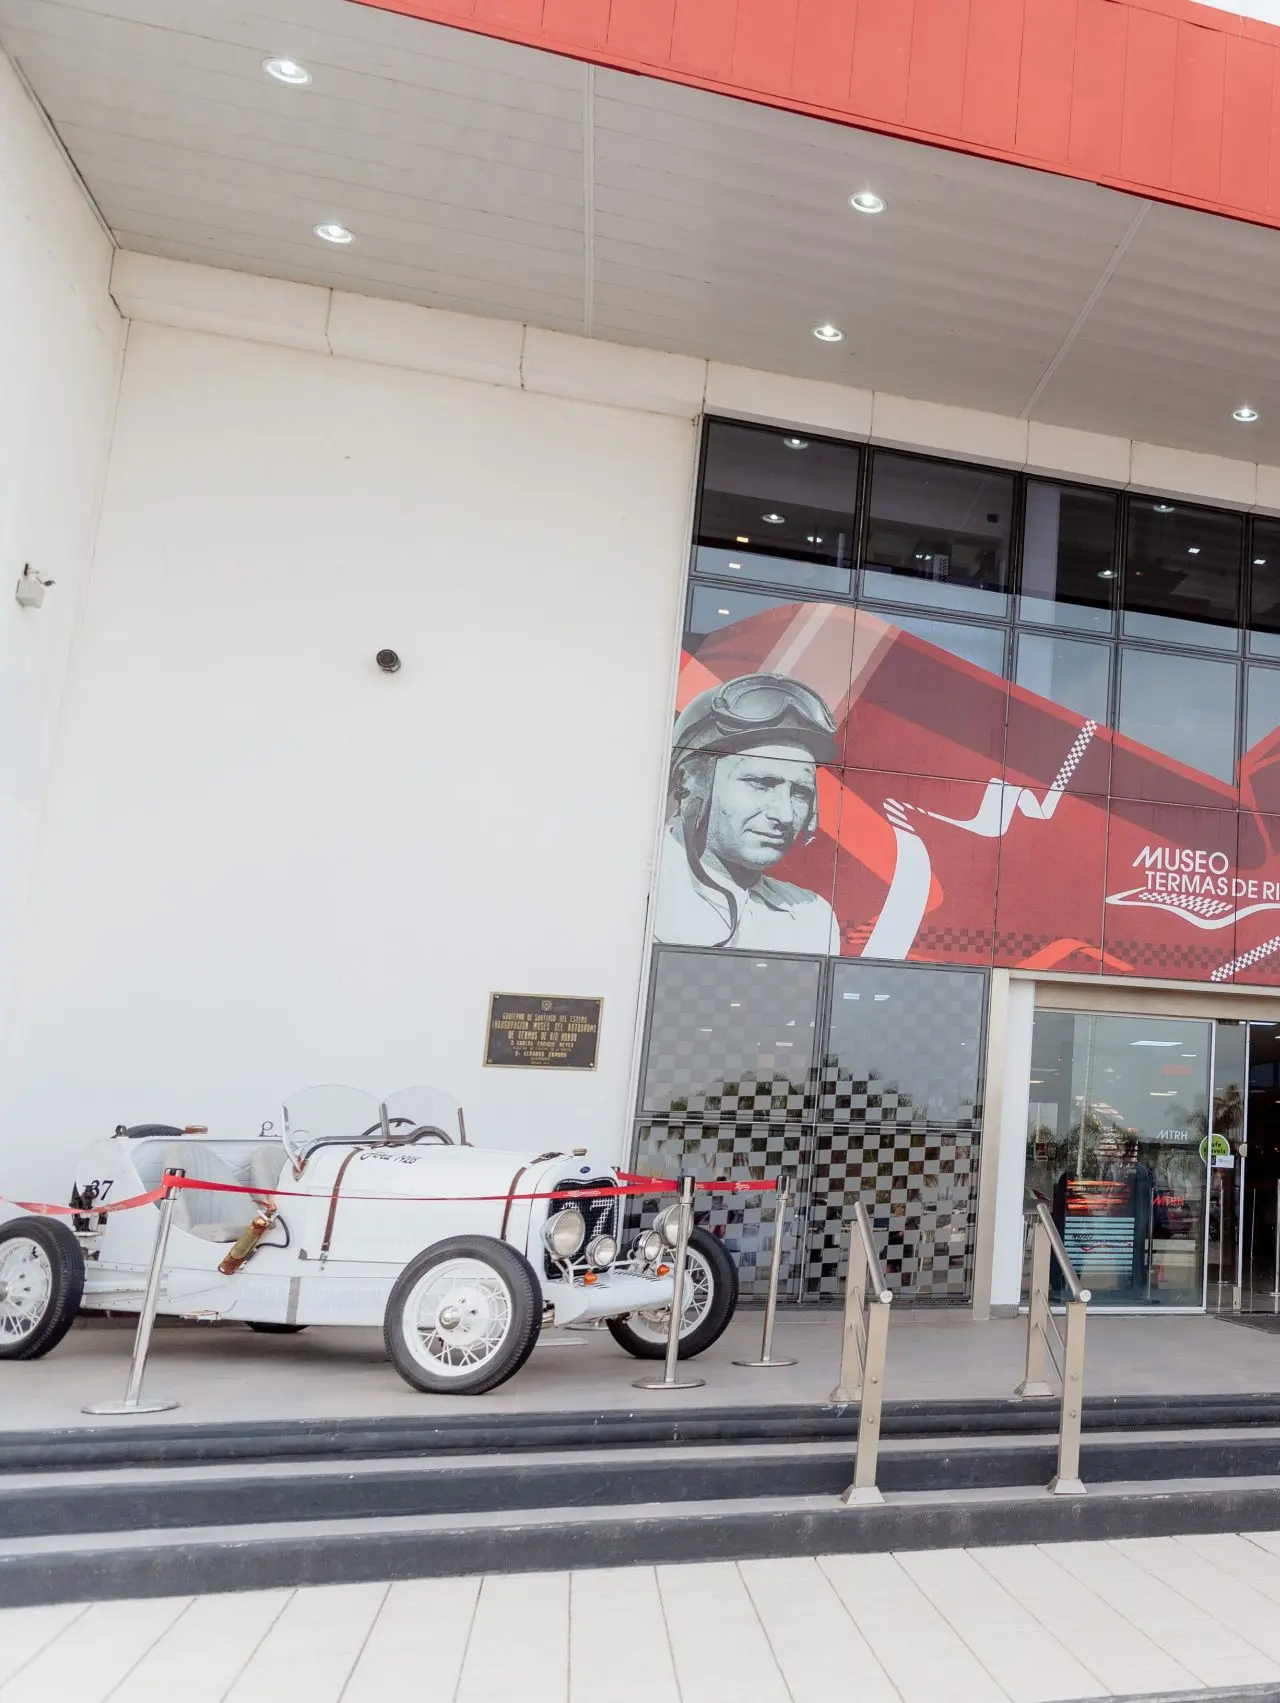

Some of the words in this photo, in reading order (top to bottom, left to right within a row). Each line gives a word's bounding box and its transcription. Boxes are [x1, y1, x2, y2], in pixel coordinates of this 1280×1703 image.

[1132, 846, 1229, 875] MUSEO
[1145, 870, 1228, 896] TERMAS
[1232, 878, 1258, 899] DE
[1156, 1128, 1188, 1140] MTRH
